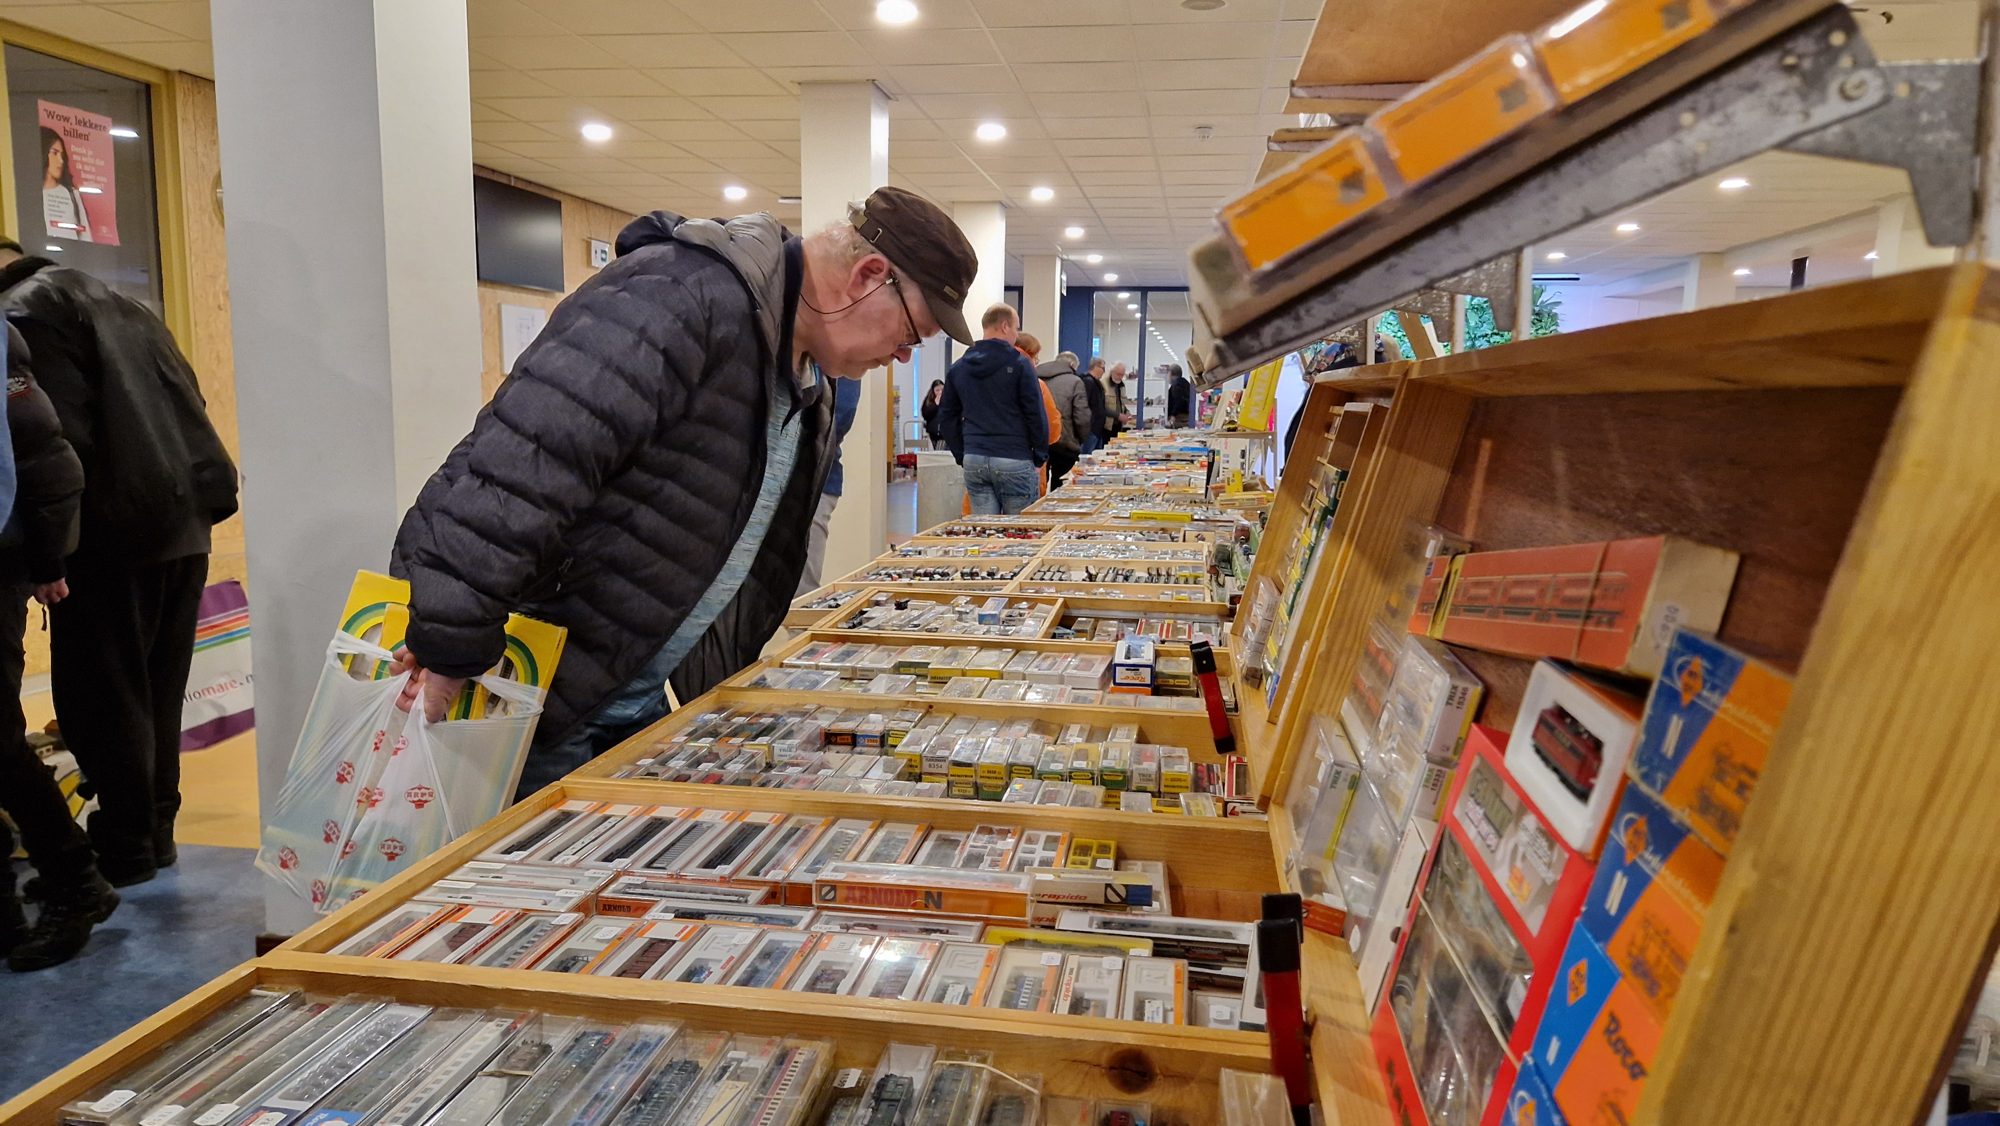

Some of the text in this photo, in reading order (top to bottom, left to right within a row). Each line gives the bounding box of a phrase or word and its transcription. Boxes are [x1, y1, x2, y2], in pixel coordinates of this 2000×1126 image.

[75, 116, 107, 132] lekkere
[1446, 685, 1458, 706] TRIX
[1330, 769, 1342, 789] TRIX
[845, 885, 917, 907] ARNOLD
[1040, 892, 1088, 901] rapido
[602, 903, 632, 913] ARNOLD
